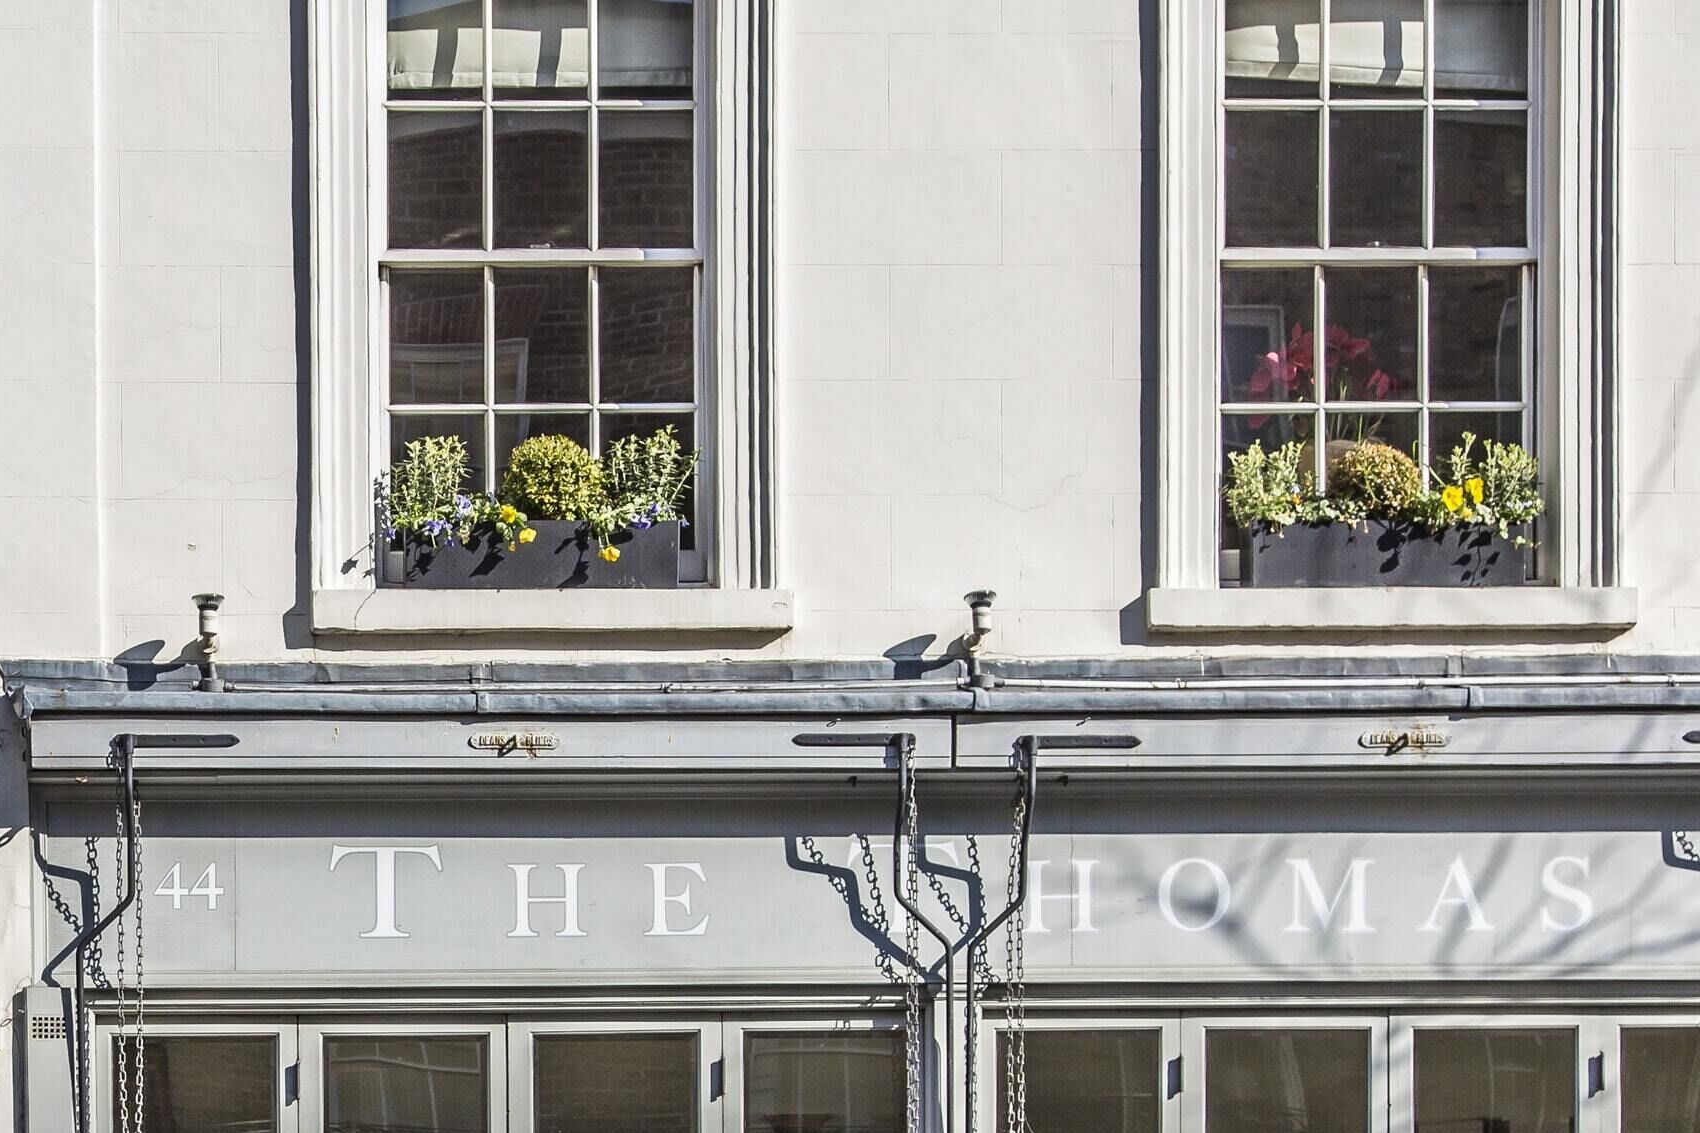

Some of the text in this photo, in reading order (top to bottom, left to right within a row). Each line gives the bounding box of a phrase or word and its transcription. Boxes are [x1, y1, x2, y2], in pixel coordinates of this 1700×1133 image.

[153, 862, 225, 911] 44
[329, 840, 1595, 939] THE THOMAS
